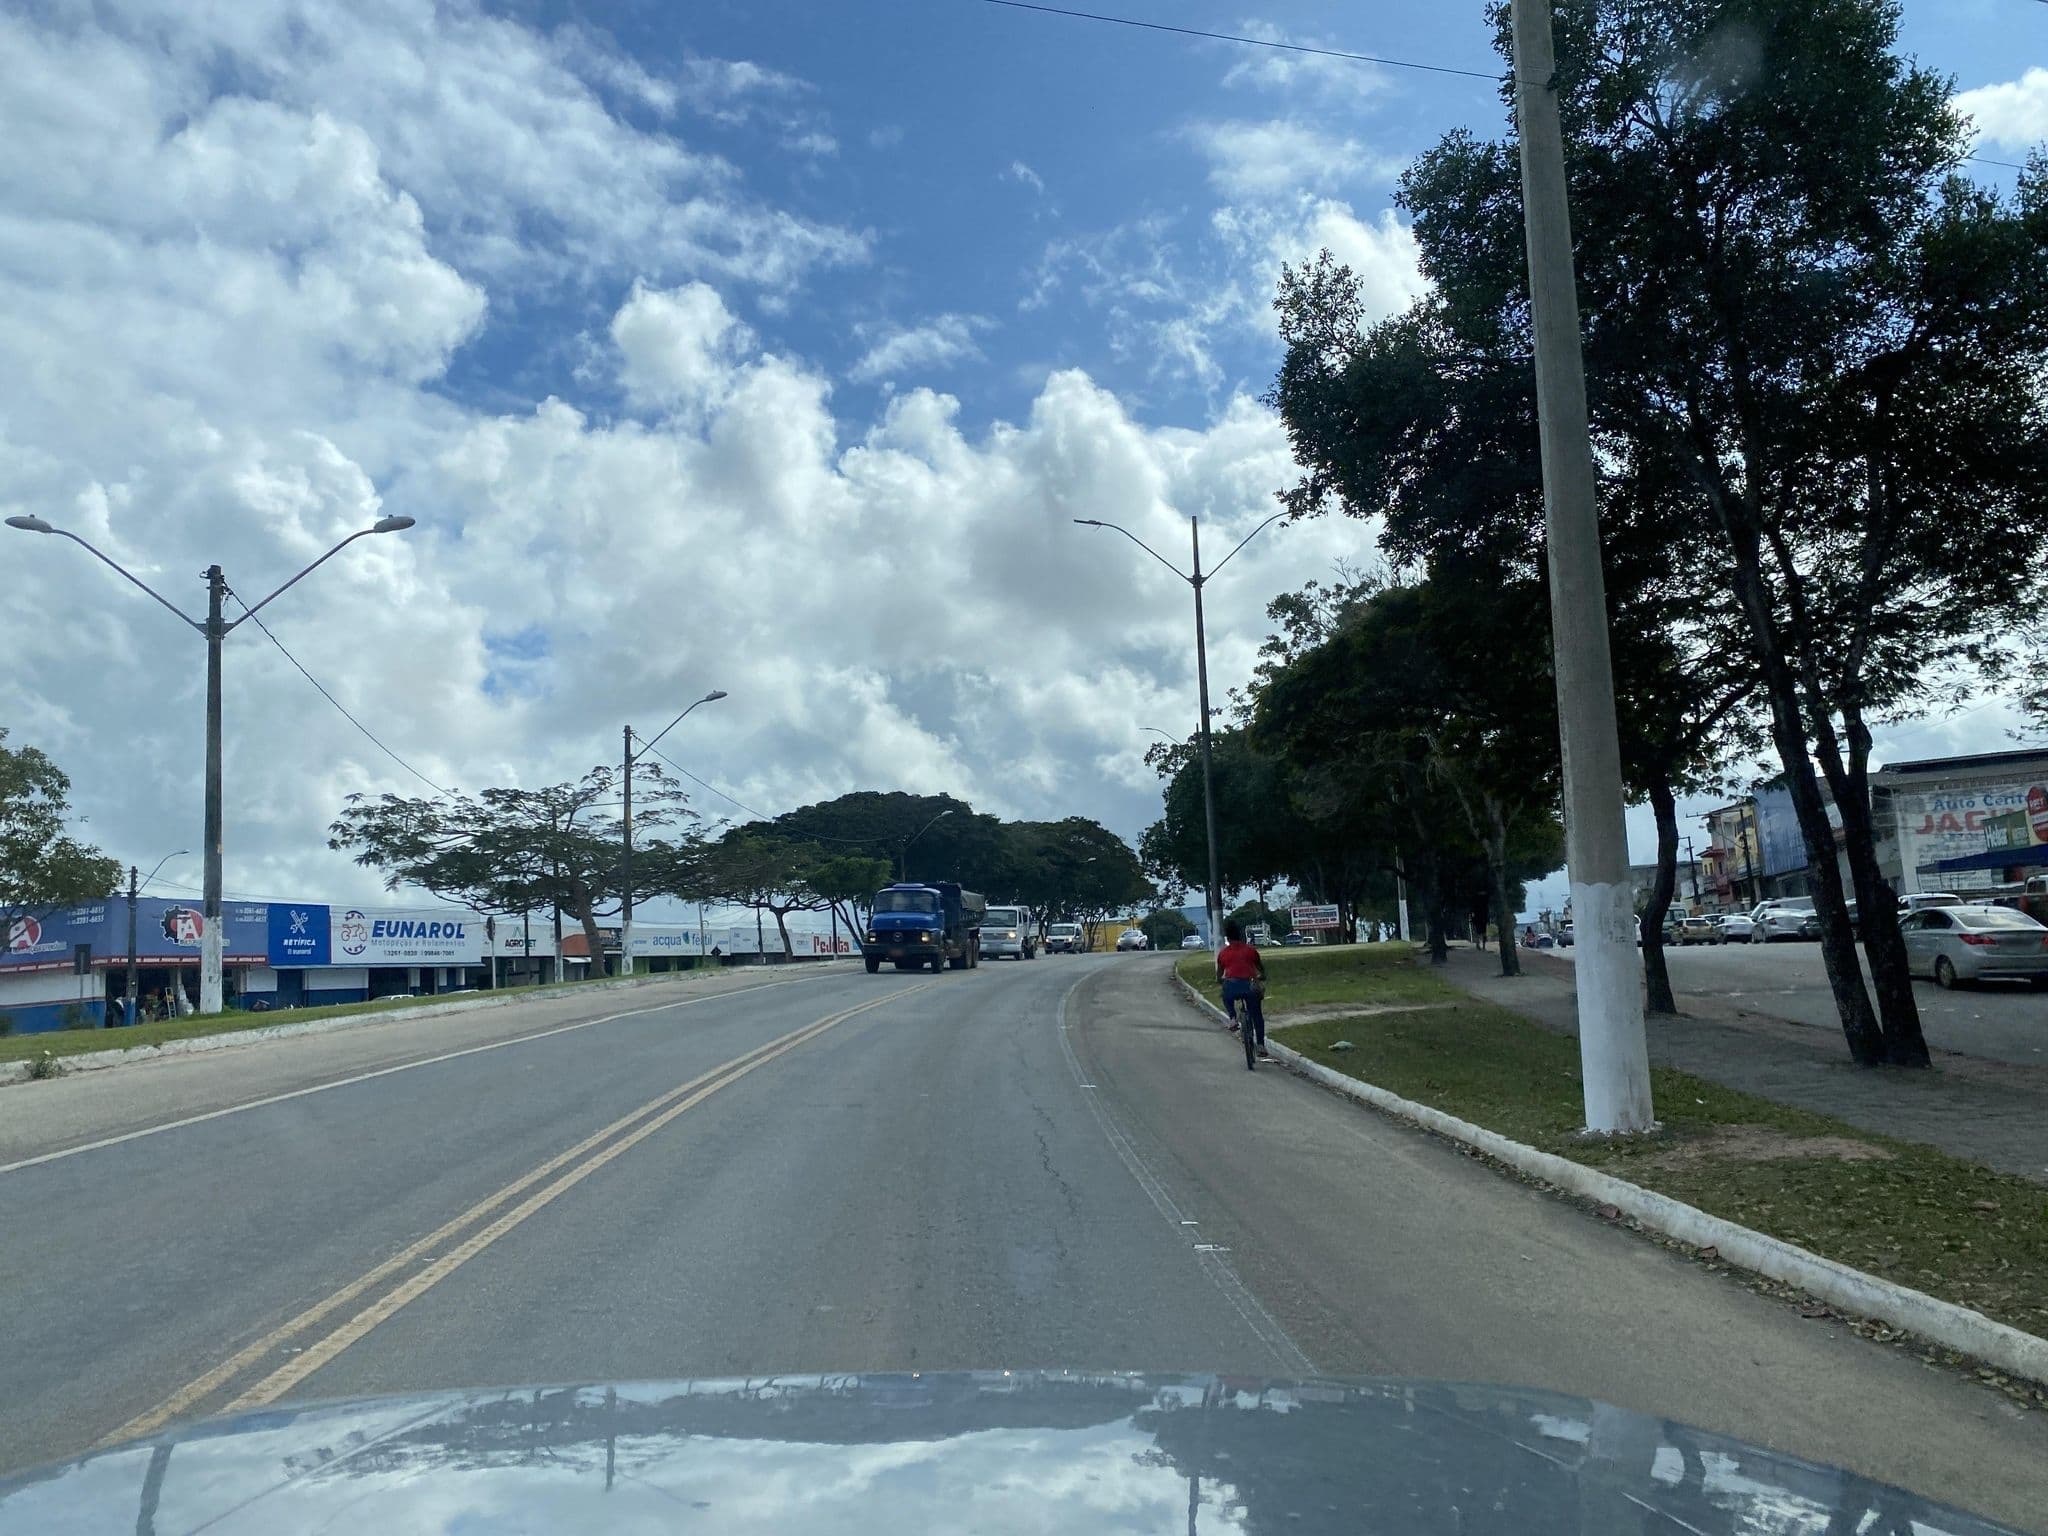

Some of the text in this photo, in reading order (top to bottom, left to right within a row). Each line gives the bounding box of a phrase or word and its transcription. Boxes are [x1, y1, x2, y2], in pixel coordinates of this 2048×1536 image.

[1983, 794, 2028, 807] Cent
[371, 920, 465, 939] EUNAROL
[652, 935, 682, 949] acqua
